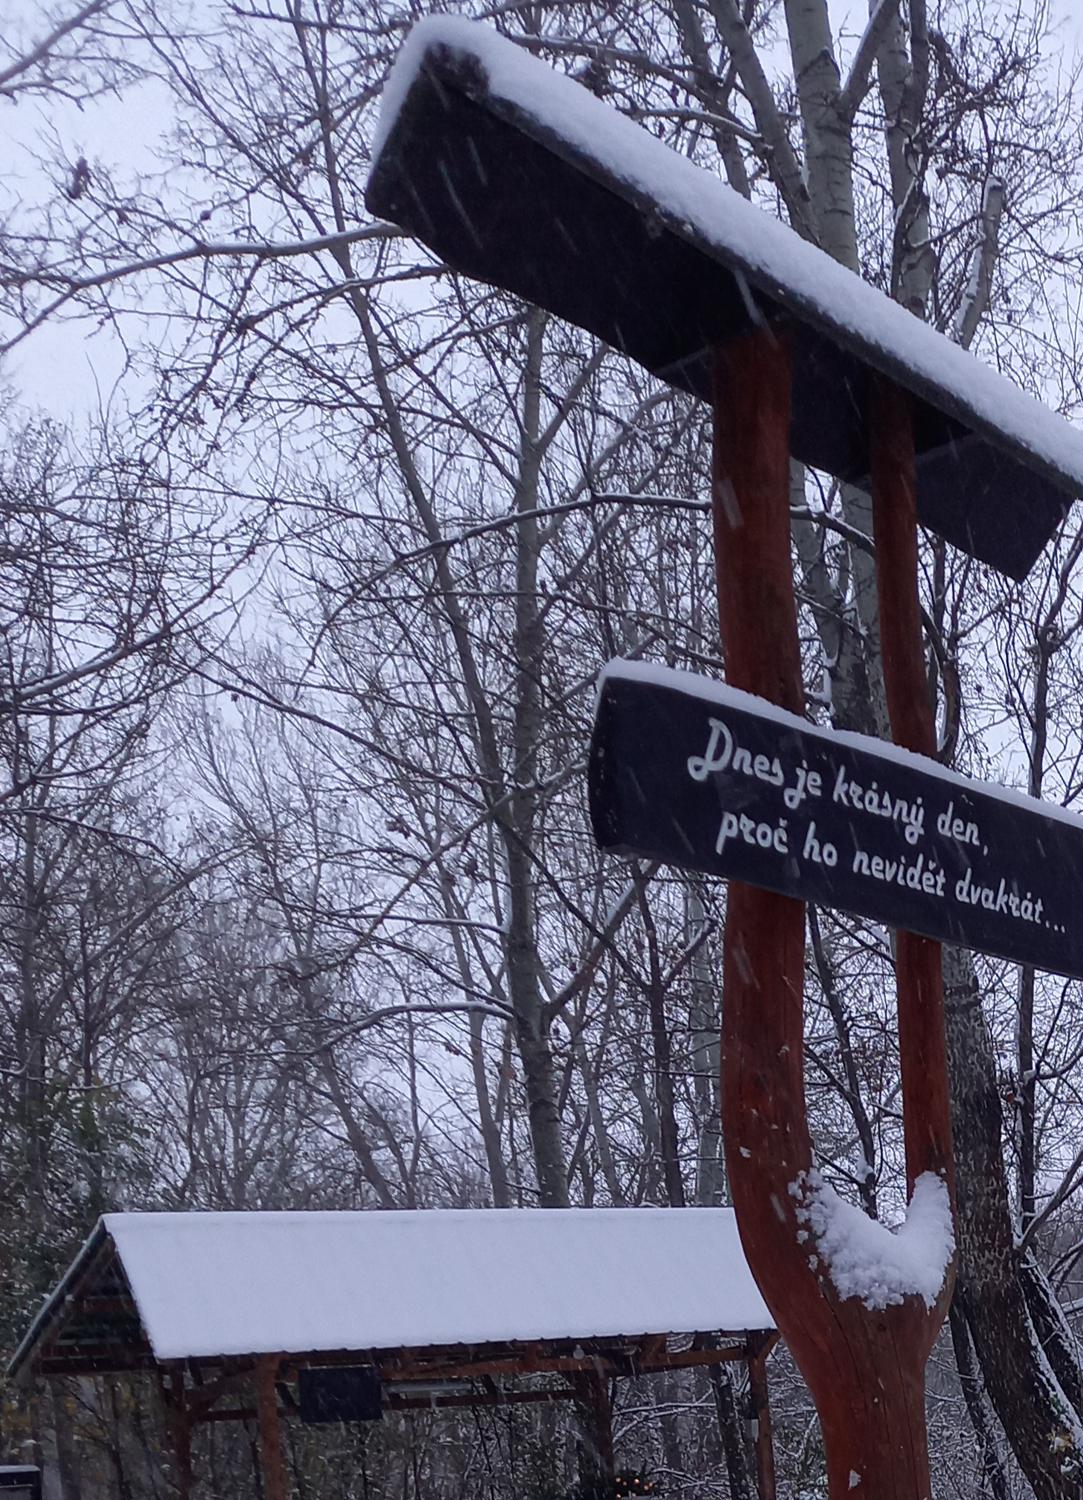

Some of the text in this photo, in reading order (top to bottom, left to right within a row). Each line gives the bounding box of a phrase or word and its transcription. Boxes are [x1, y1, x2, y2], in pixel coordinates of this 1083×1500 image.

[687, 717, 988, 855] Dnes je krásný den,
[716, 811, 788, 855] proč
[803, 821, 838, 866] ho
[853, 850, 946, 896] nevidět
